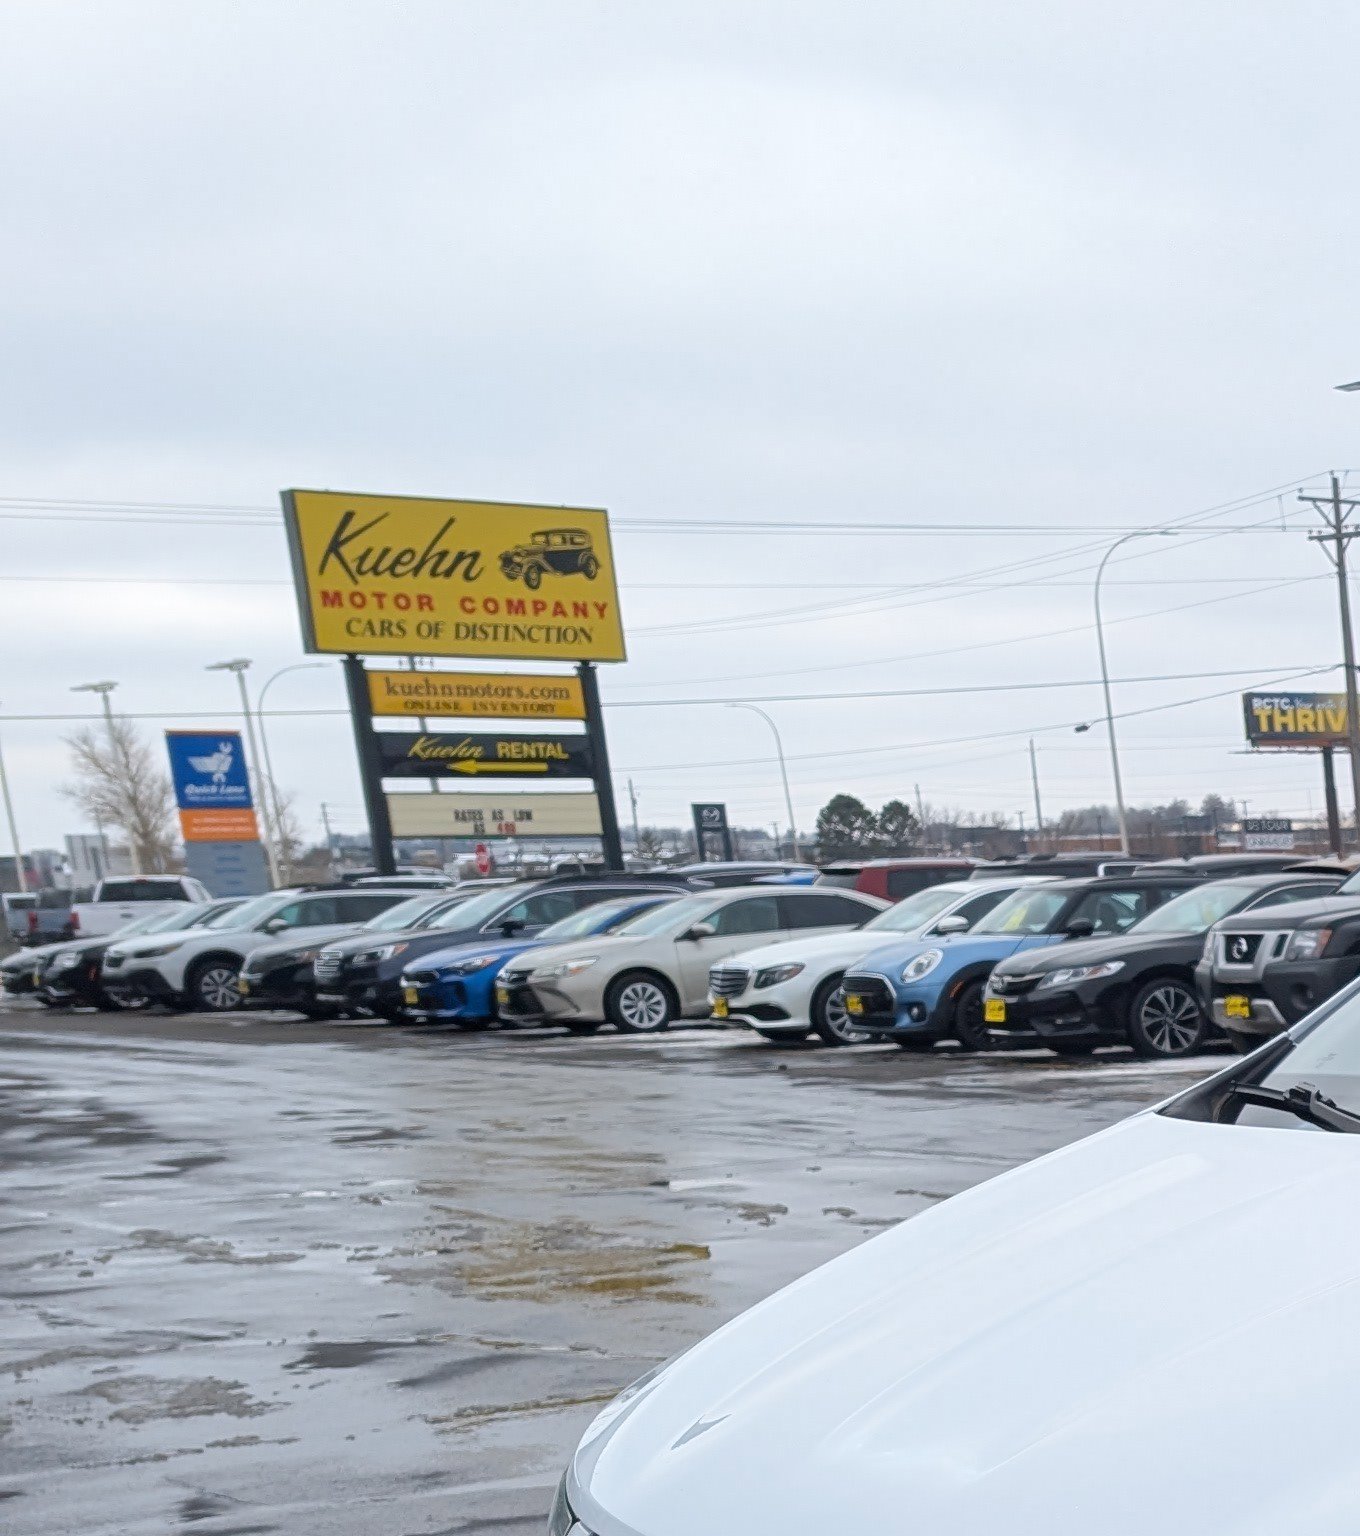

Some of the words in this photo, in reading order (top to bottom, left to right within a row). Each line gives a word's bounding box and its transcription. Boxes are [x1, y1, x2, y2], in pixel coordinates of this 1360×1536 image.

[318, 510, 484, 585] Kuehn
[320, 589, 436, 612] MOTOR
[459, 595, 609, 620] COMPANY
[345, 617, 406, 639] CARS
[416, 620, 446, 641] OF
[454, 621, 594, 645] DISTINCTION
[384, 676, 571, 701] kuehnmotors.com
[402, 700, 461, 712] ONLINE
[471, 701, 556, 714] INVENTORY
[407, 736, 484, 759] Kuehn
[496, 741, 569, 759] RENTAL
